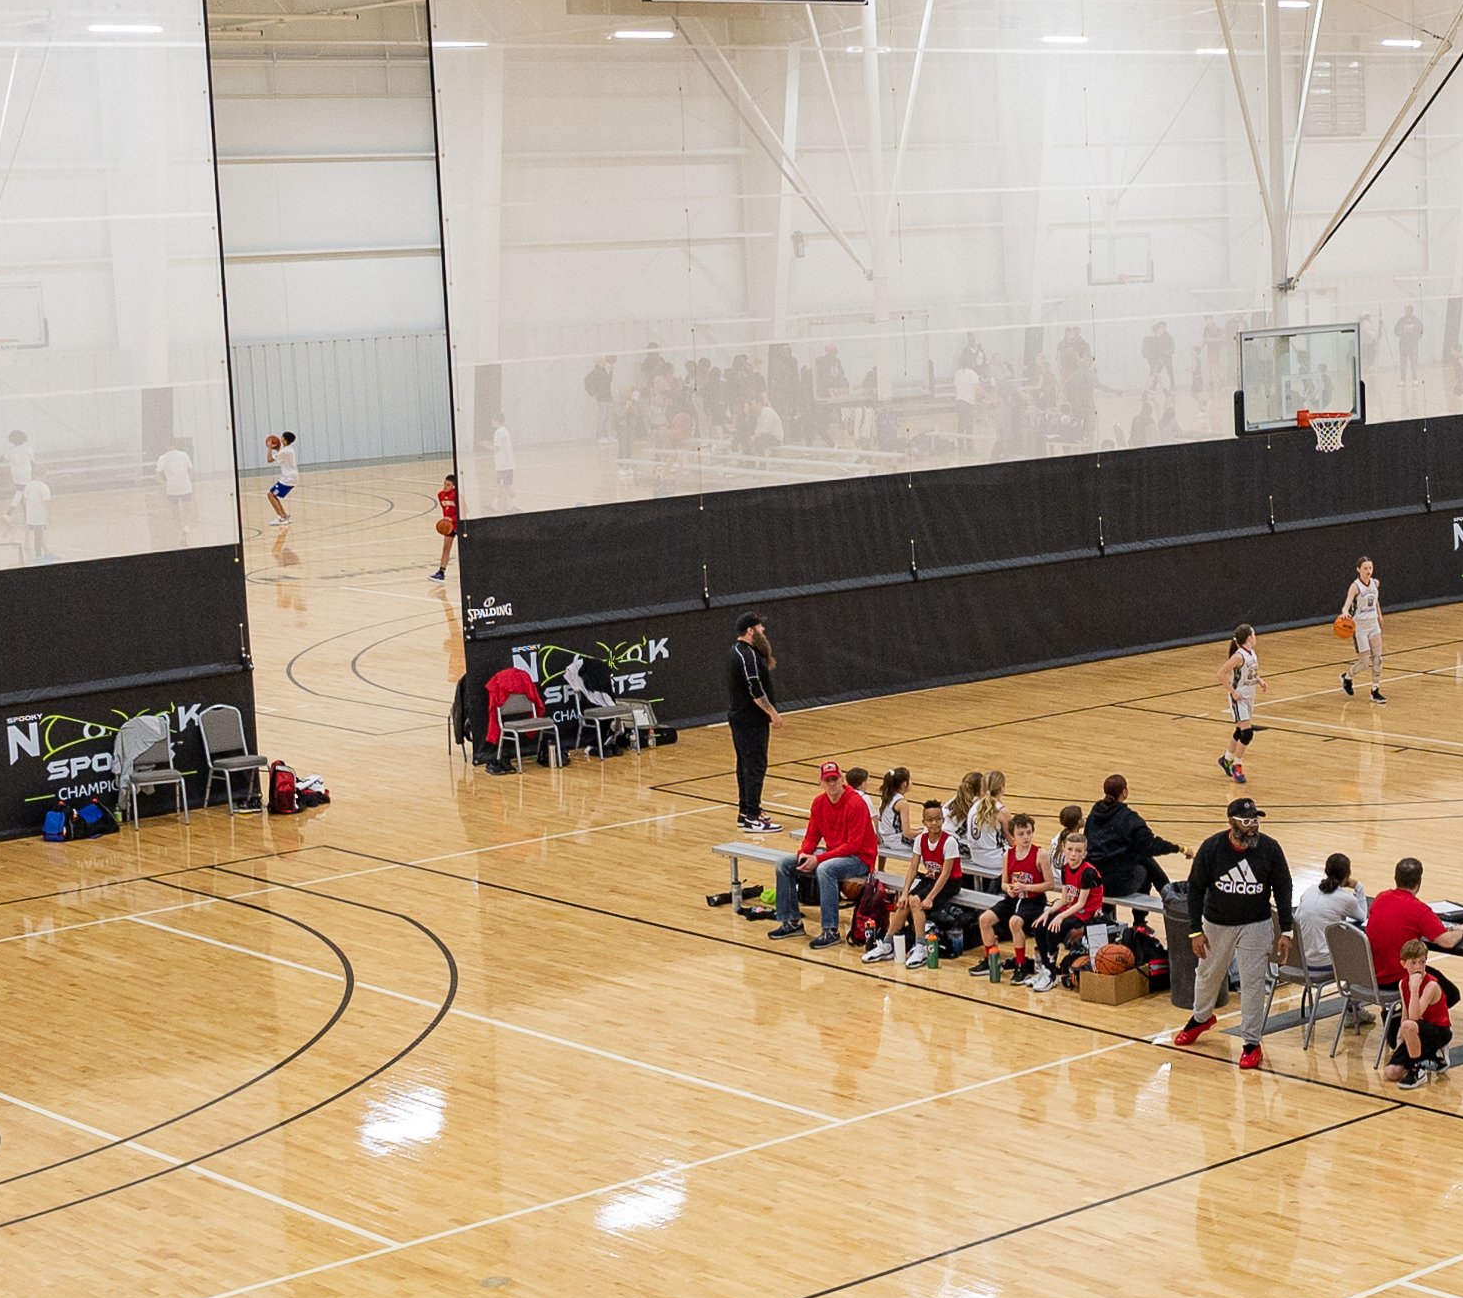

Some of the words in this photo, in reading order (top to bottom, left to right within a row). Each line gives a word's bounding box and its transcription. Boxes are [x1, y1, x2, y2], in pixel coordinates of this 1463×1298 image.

[467, 603, 513, 622] SPALDING
[6, 713, 43, 724] SPOOKY
[1214, 880, 1264, 895] adidas
